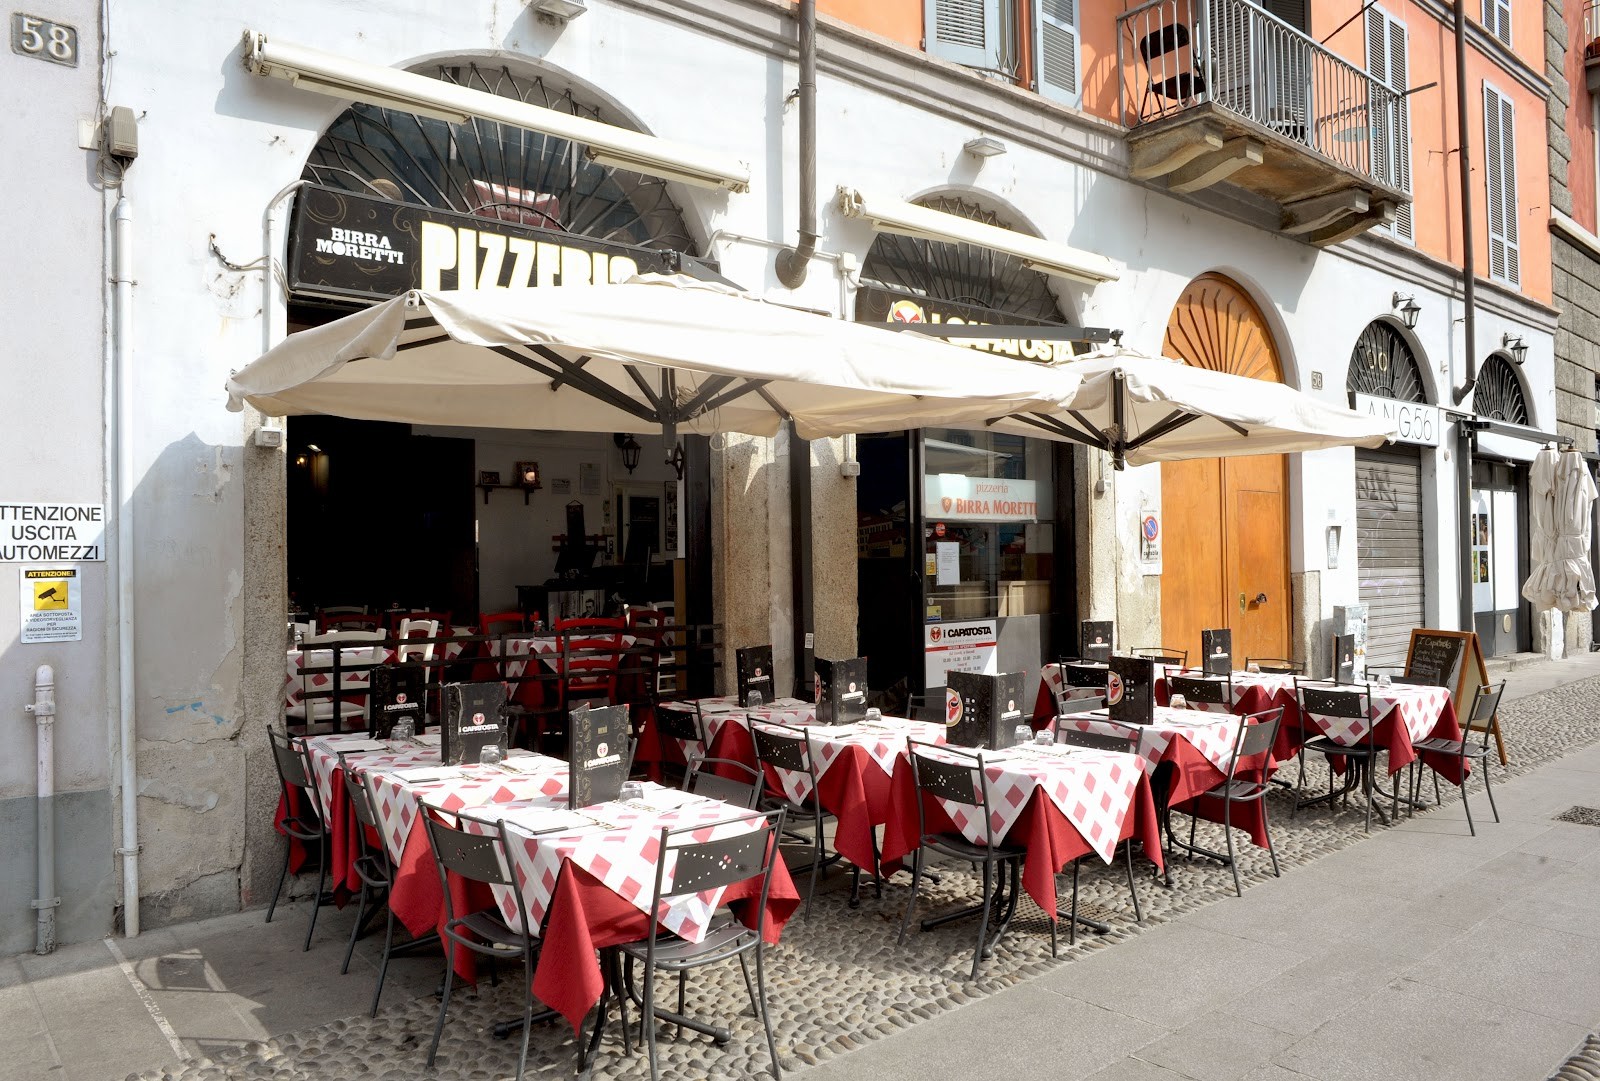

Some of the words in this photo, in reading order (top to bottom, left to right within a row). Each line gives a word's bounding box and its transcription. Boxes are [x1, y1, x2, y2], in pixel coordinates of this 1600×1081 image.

[21, 16, 72, 60] 58
[331, 227, 392, 250] BIRRA
[316, 239, 404, 265] MORETTI
[976, 482, 1008, 494] pizzeria
[956, 498, 990, 514] BIRRA
[994, 500, 1037, 515] MORETTI
[12, 525, 77, 541] USCITA
[0, 545, 98, 560] UTOMEZZI
[948, 626, 991, 638] CAPATOSTA
[462, 723, 499, 733] CAPATOSTA
